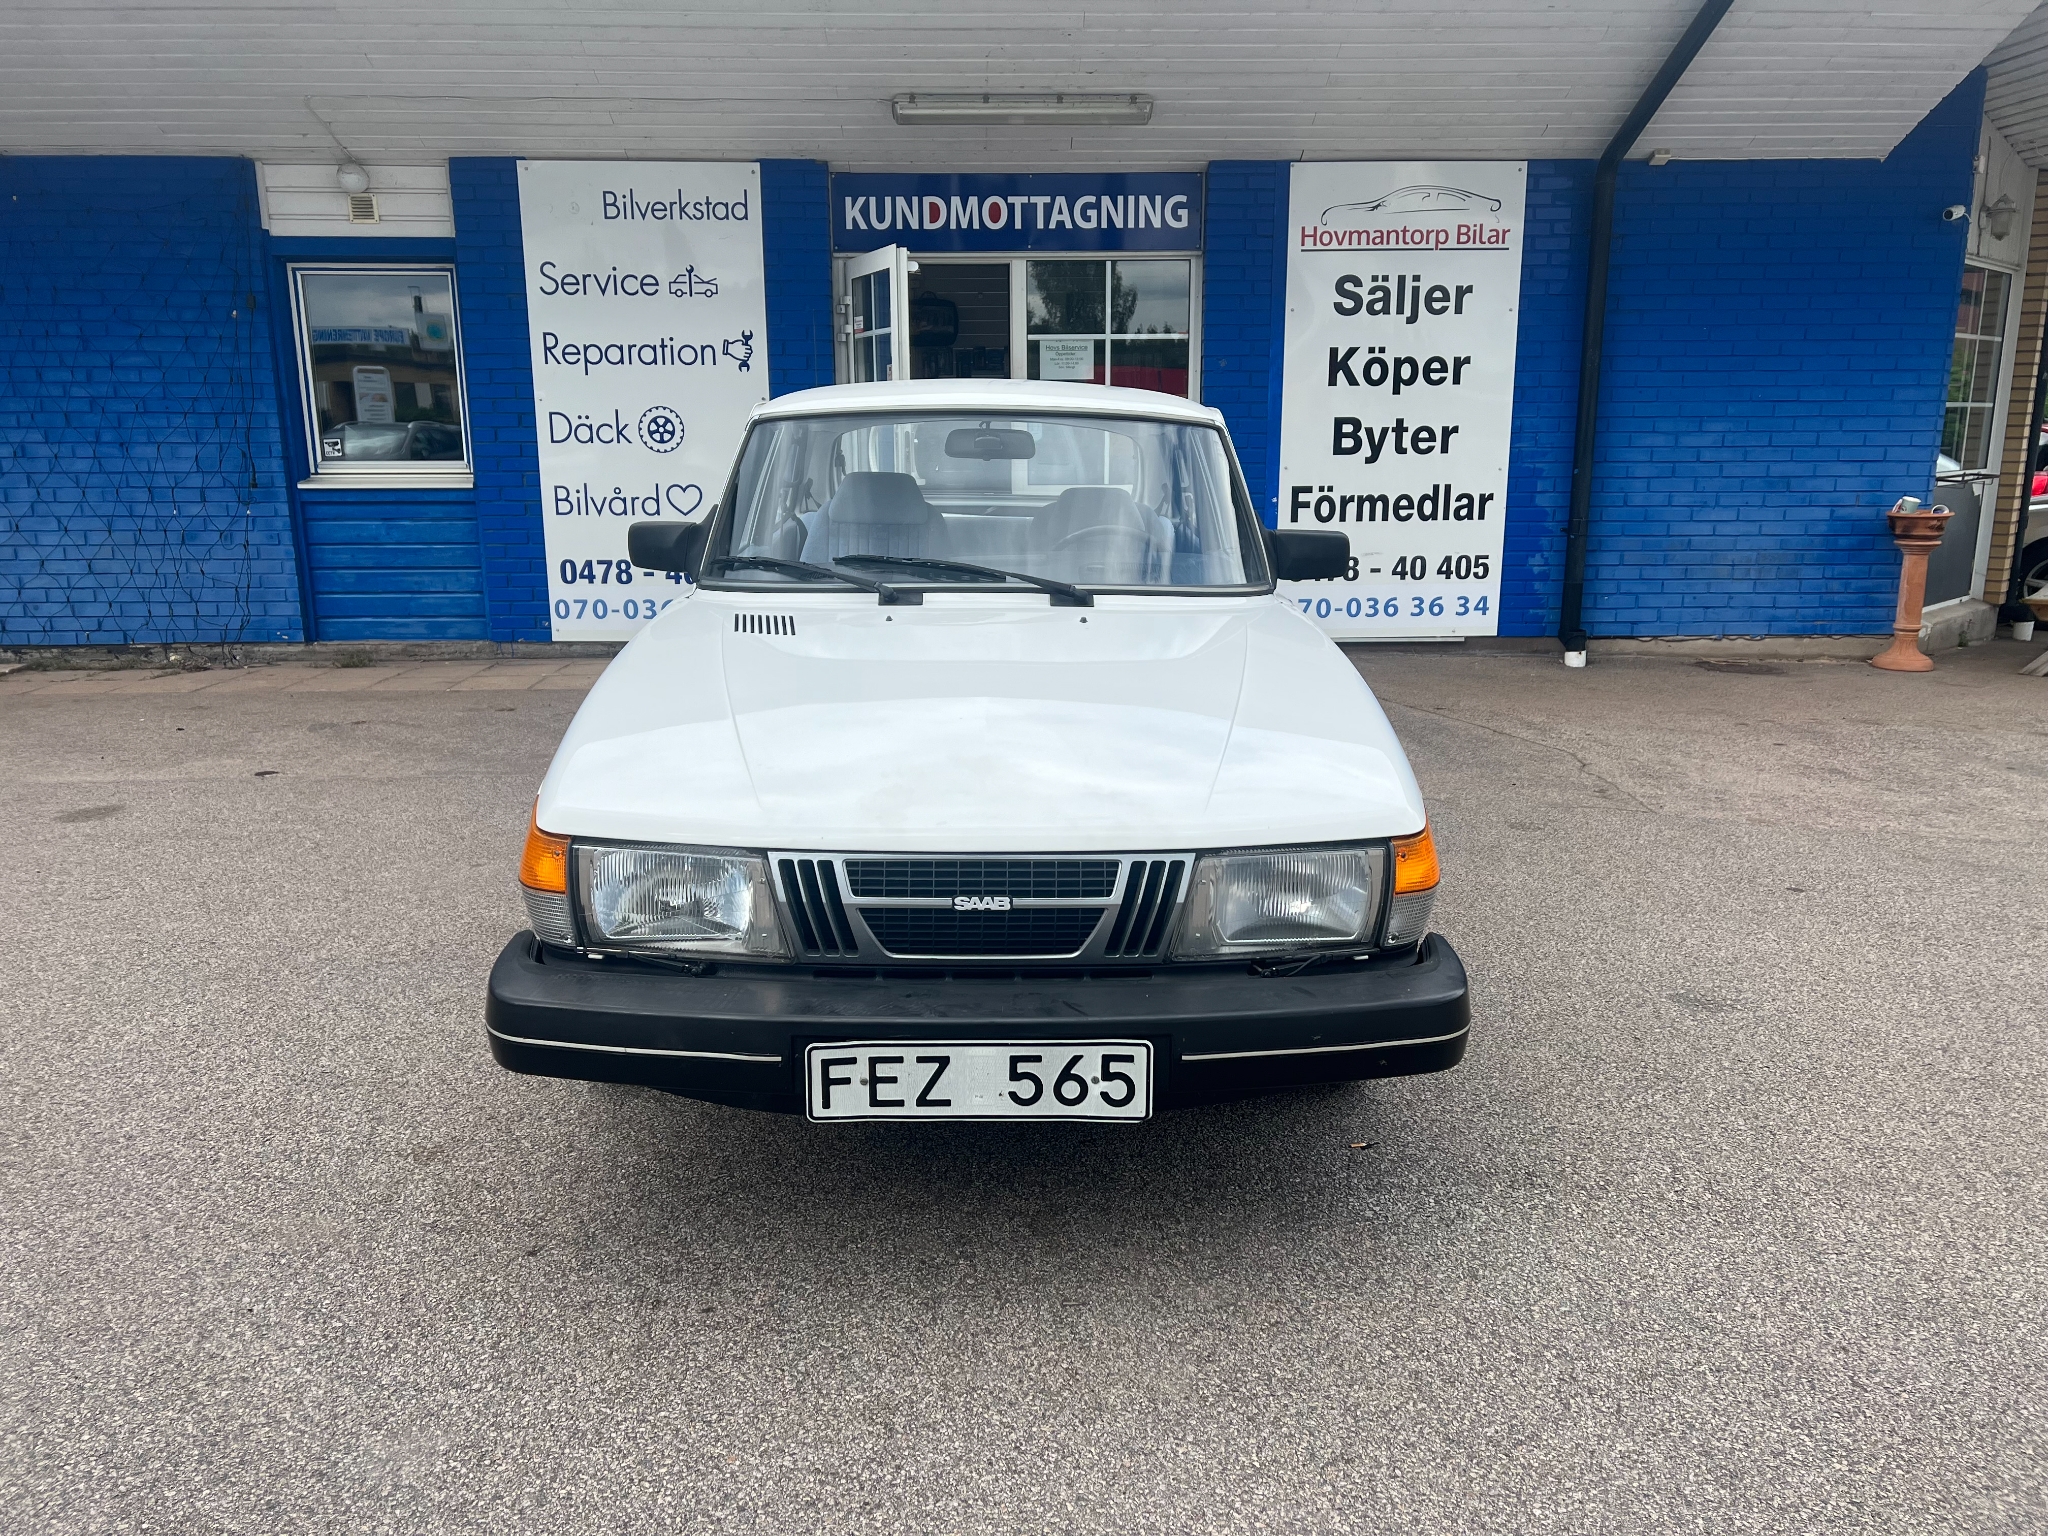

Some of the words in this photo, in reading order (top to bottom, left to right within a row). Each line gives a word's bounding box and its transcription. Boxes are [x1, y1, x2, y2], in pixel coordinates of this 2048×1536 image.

[602, 188, 749, 221] Bilverkstad
[844, 195, 1189, 230] KUNDMOTTAGNING
[1300, 225, 1450, 251] Hovmantorp
[1456, 223, 1511, 245] Bilar
[539, 261, 660, 297] Service
[1333, 274, 1474, 325] Säljer
[542, 331, 717, 376] Reparation
[1327, 346, 1472, 396] Köper
[548, 408, 633, 444] Däck
[1332, 416, 1460, 465] Byter
[553, 482, 661, 517] Bilvård
[1290, 483, 1495, 523] Förmedlar
[559, 558, 633, 585] 0478
[1391, 555, 1427, 581] 40
[1436, 554, 1490, 580] 405
[554, 598, 674, 620] 070-03
[1297, 596, 1399, 619] 70-036
[1410, 596, 1444, 617] 36
[1455, 595, 1490, 616] 34
[953, 896, 1011, 911] SAAB
[820, 1055, 952, 1110] FEZ
[1007, 1054, 1136, 1108] 565
